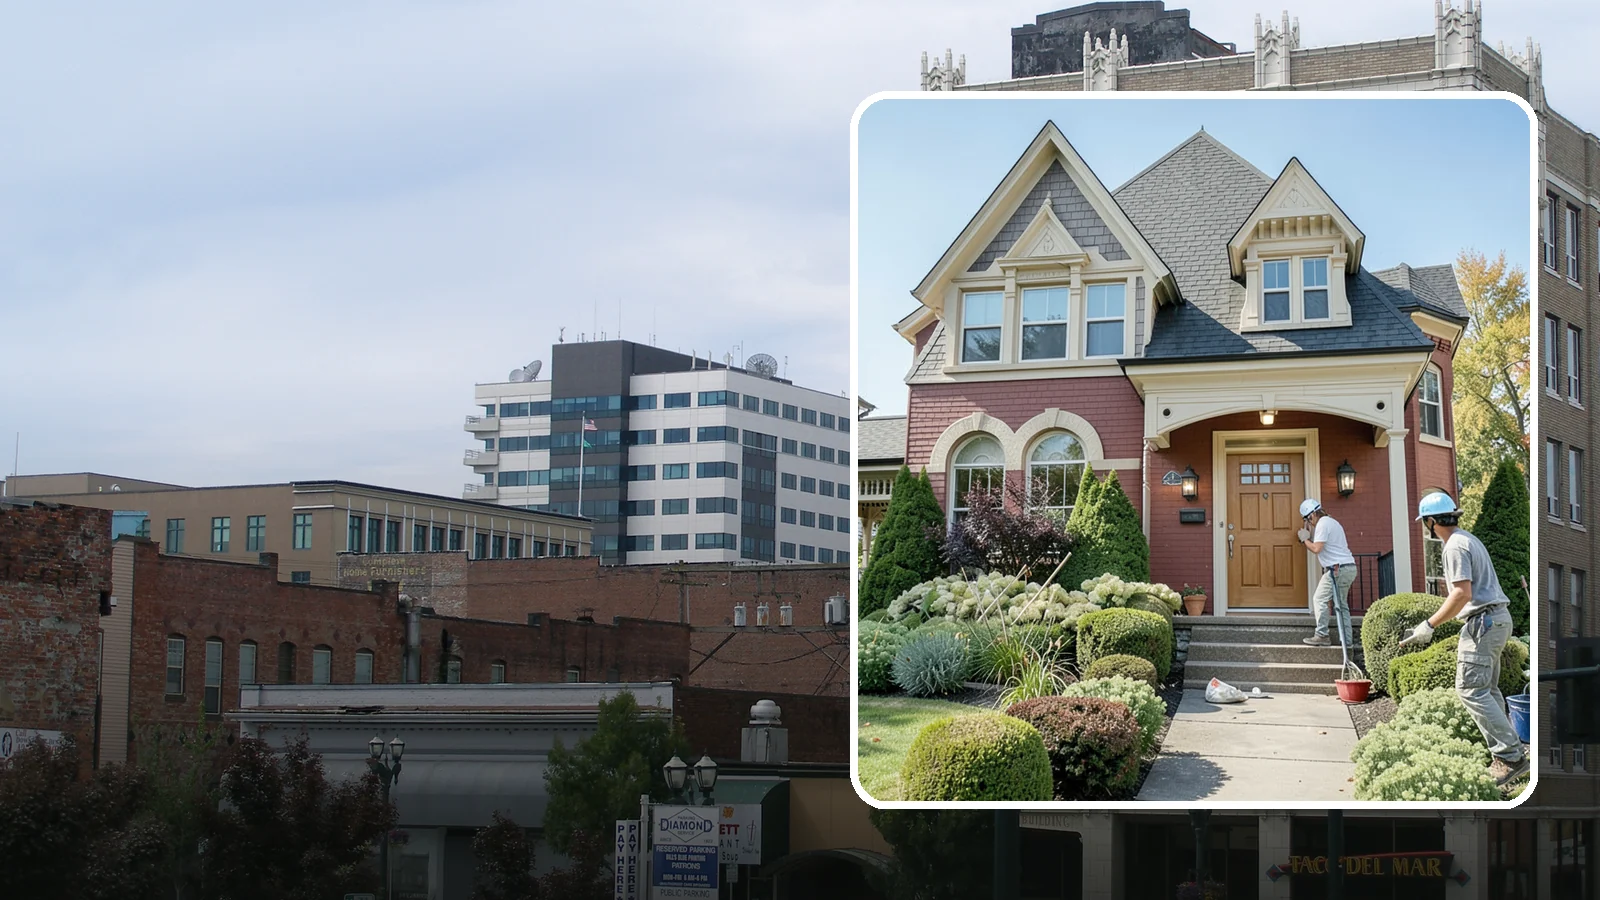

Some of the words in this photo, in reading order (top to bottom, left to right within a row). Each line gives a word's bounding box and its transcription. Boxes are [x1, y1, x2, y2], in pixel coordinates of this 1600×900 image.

[370, 565, 428, 576] Furnishers
[660, 818, 713, 833] DIAMOND
[1022, 815, 1069, 827] BUILDING
[617, 825, 625, 853] PAY
[628, 824, 637, 853] PAY
[656, 845, 688, 853] RESERVED
[689, 846, 716, 854] PARKING
[671, 862, 701, 870] PATRONS
[1289, 855, 1329, 874] TAC
[1346, 856, 1385, 875] DEL
[1393, 857, 1443, 877] MAR
[616, 856, 625, 894] HERE
[627, 855, 636, 893] HERE
[660, 889, 682, 897] PUBLIC
[683, 889, 710, 898] PARKING
